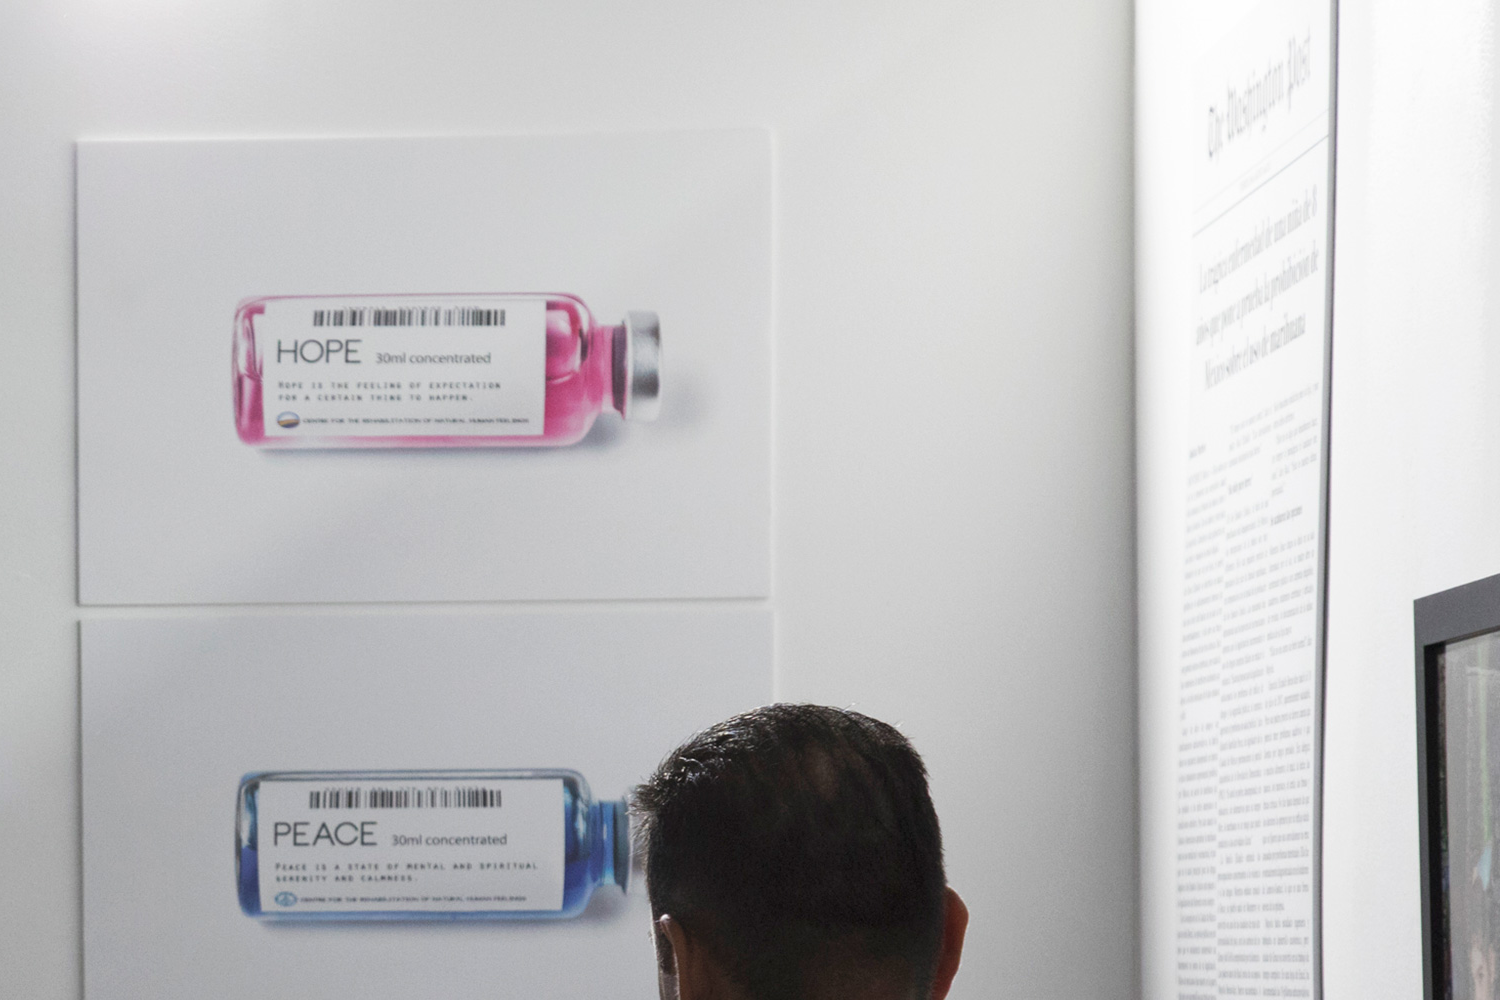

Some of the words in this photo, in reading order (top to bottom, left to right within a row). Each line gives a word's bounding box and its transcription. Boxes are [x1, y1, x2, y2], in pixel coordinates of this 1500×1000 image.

[1226, 58, 1284, 141] Washington
[1288, 30, 1312, 111] Post
[276, 339, 362, 364] HOPE
[375, 352, 406, 365] 30ml
[409, 351, 492, 365] concentrated
[273, 821, 378, 847] PEACE
[391, 833, 423, 847] 30ml
[425, 832, 508, 846] concentrated
